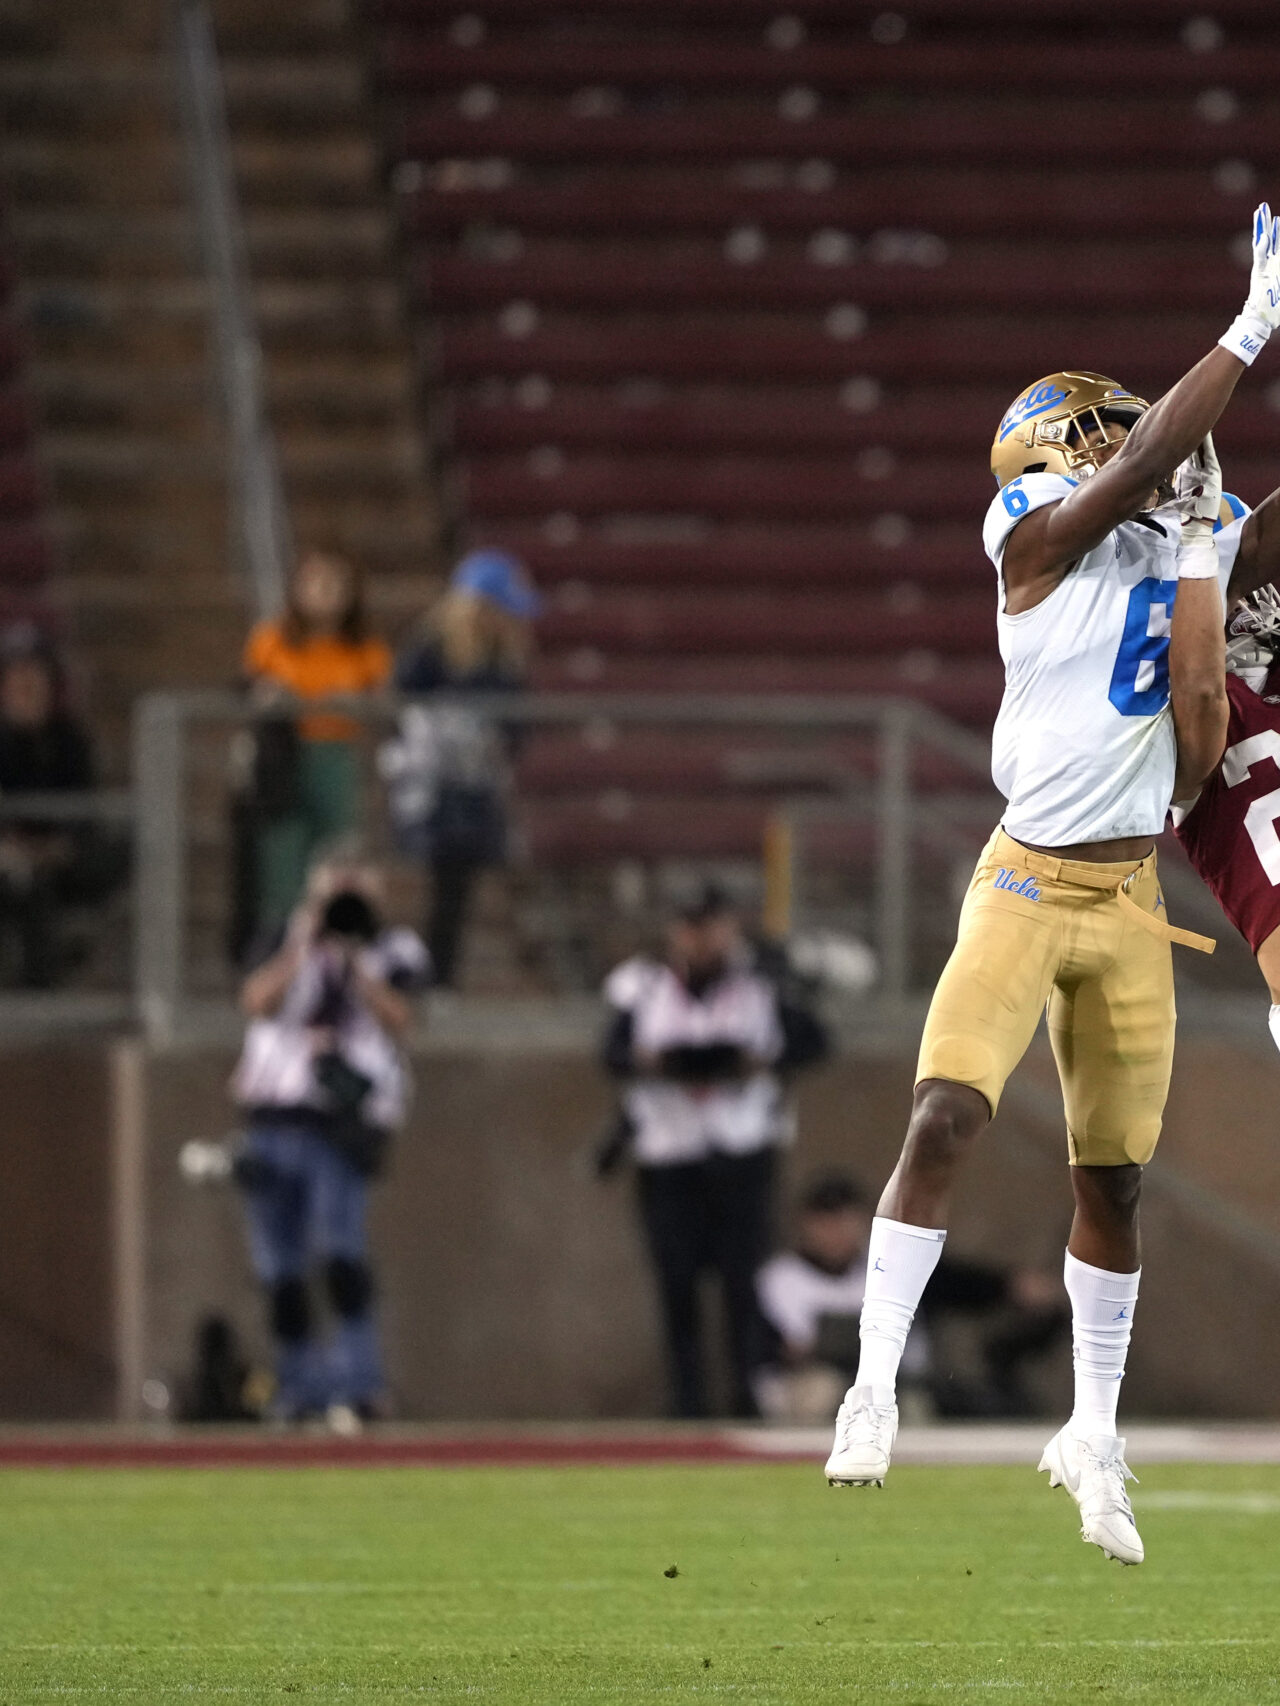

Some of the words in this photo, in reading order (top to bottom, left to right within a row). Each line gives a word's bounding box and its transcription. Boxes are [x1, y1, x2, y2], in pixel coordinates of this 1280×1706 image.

[1001, 477, 1030, 518] 6
[1108, 576, 1178, 717] 6
[992, 867, 1042, 903] Ucla
